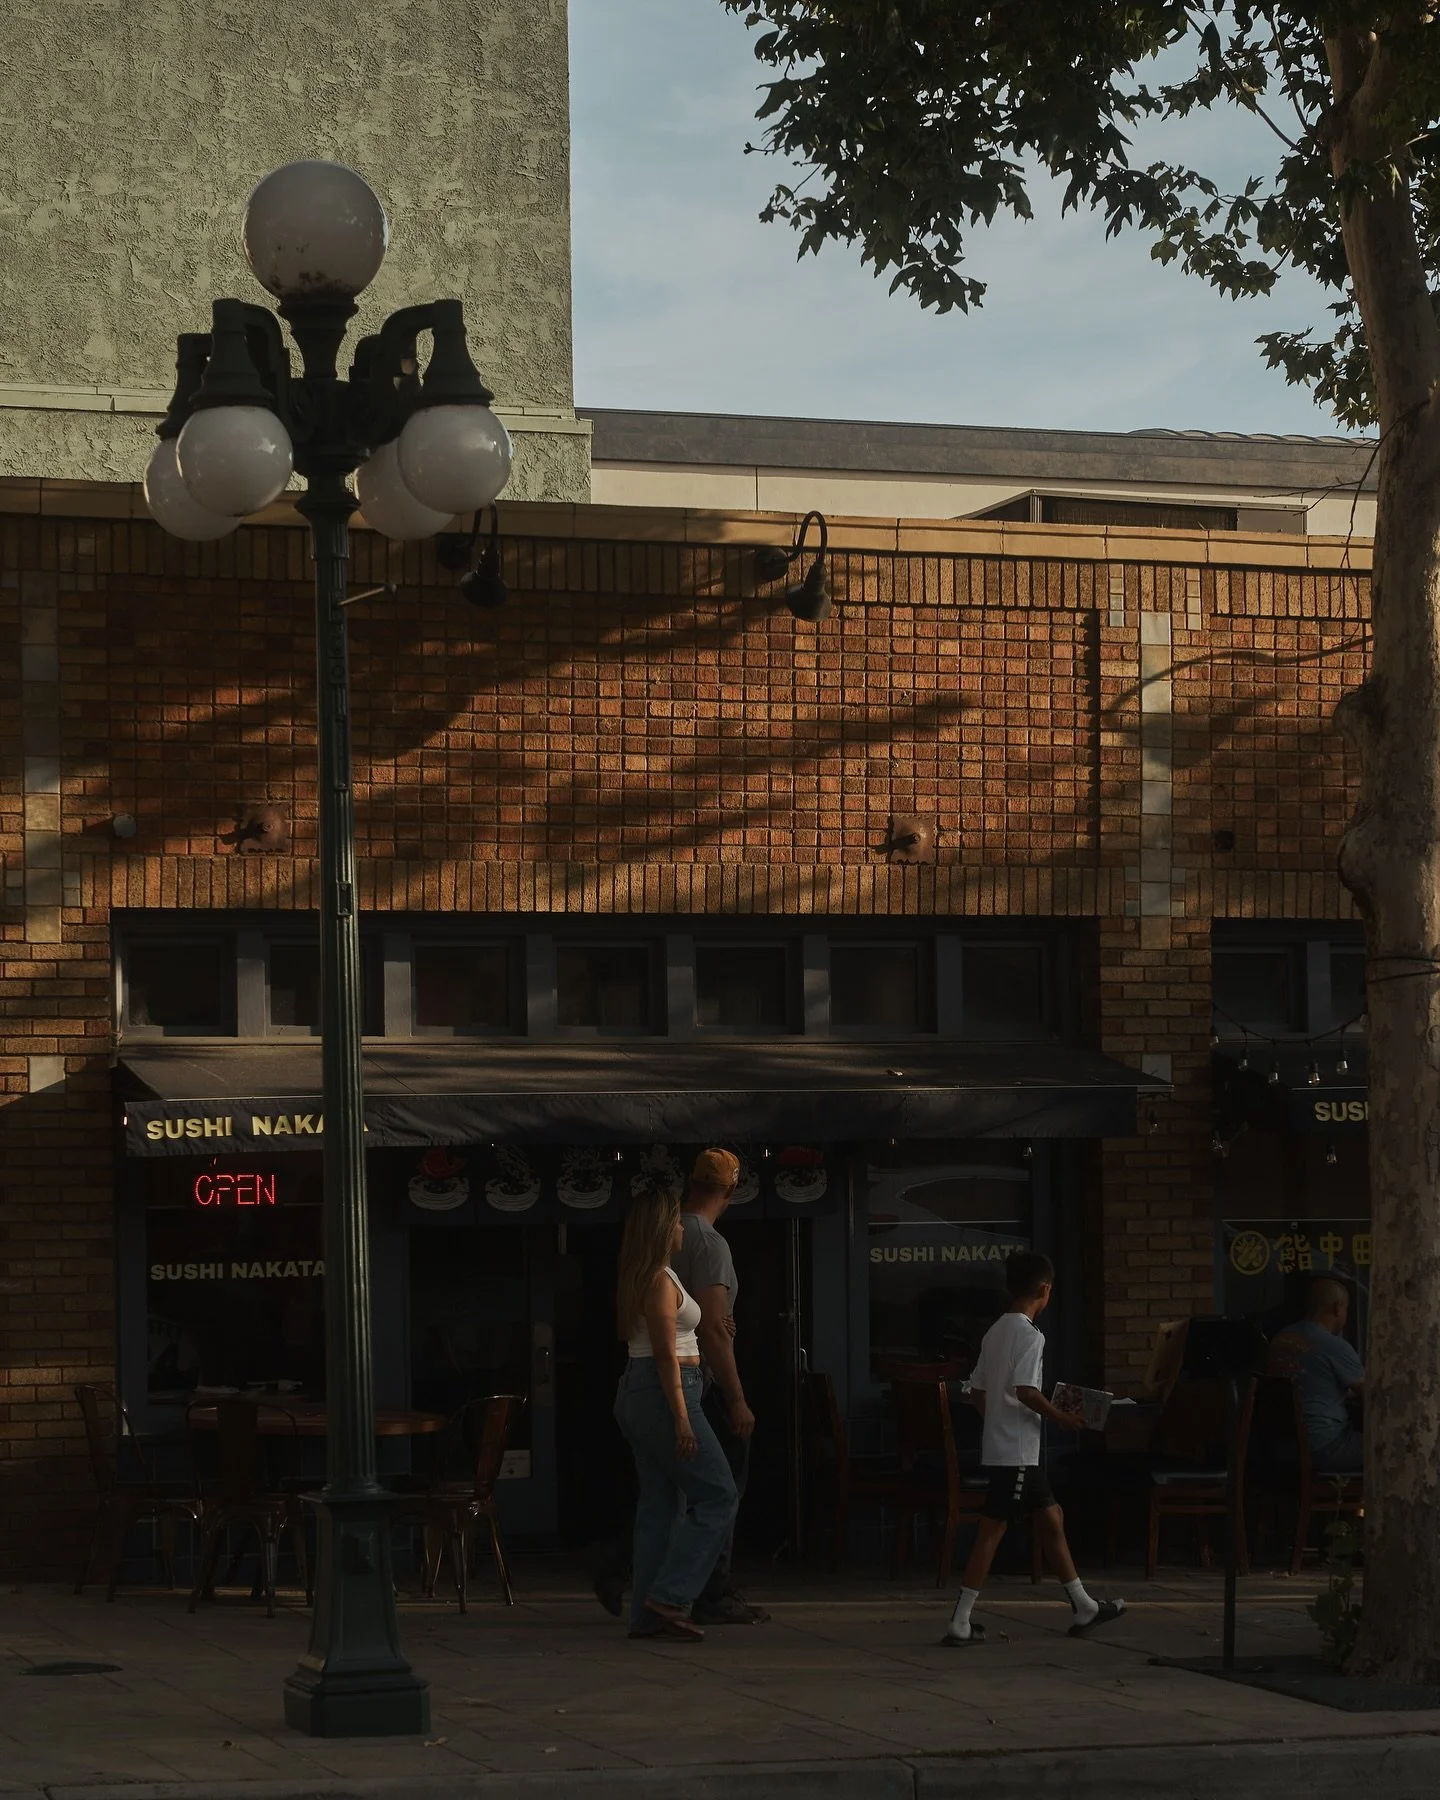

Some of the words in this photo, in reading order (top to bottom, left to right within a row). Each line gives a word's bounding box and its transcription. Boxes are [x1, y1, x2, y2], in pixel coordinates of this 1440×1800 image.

[1314, 1102, 1368, 1122] SUS
[146, 1116, 233, 1140] SUSHI
[251, 1113, 369, 1136] NAK
[193, 1173, 278, 1207] OPEN
[869, 1246, 935, 1264] SUSHI
[150, 1263, 223, 1281] SUSHI
[231, 1260, 326, 1279] NAKATA
